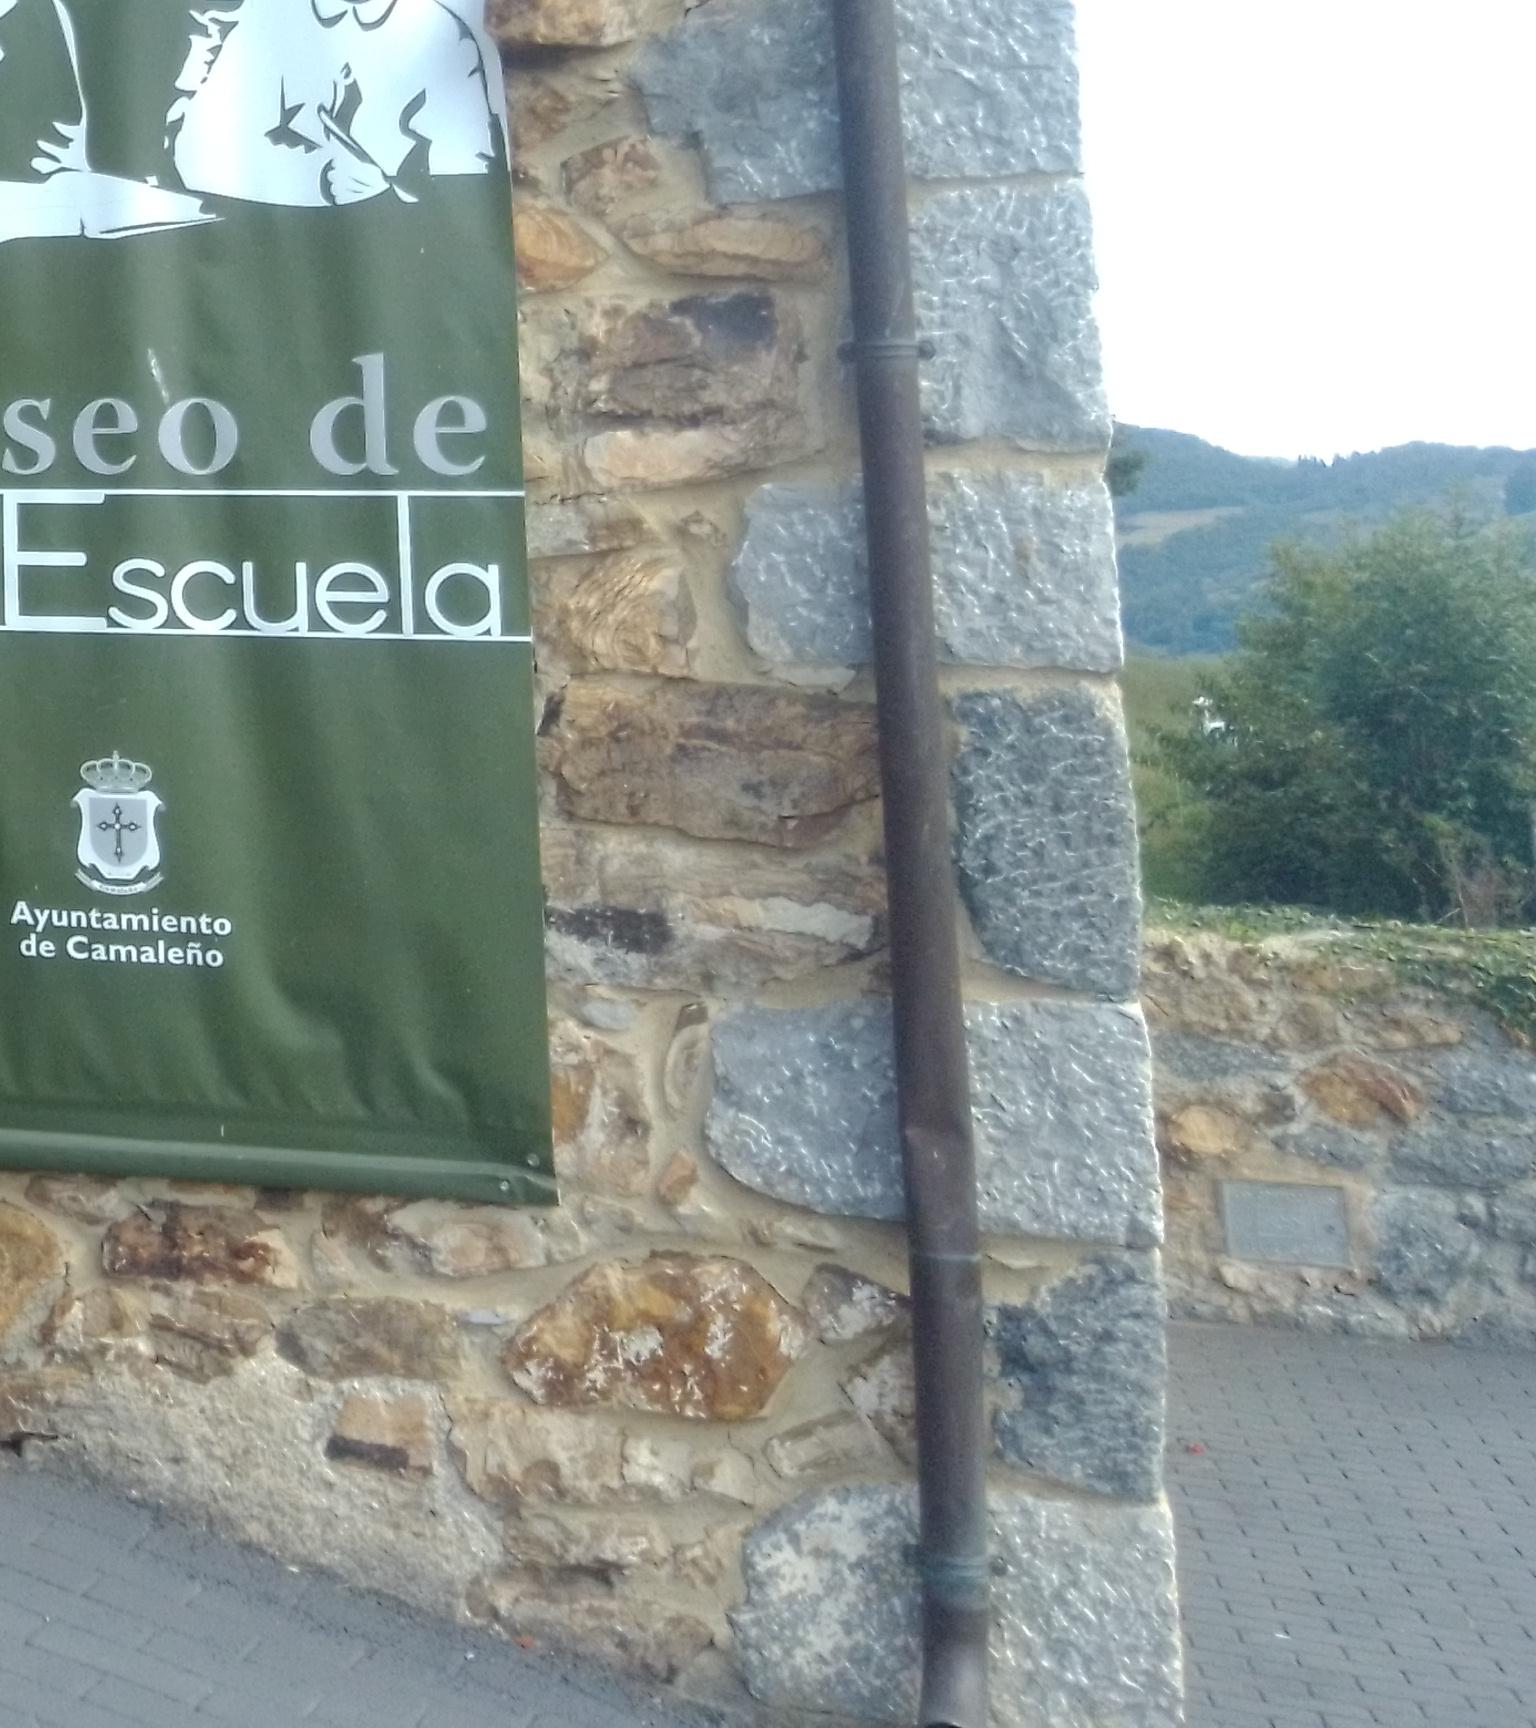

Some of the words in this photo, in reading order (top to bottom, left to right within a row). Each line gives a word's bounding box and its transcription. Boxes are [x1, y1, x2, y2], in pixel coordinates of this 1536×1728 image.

[309, 352, 488, 476] de
[2, 491, 504, 638] Escuela
[10, 901, 232, 935] Ayuntamiento
[20, 933, 56, 958] de
[66, 935, 224, 967] Camaleño
